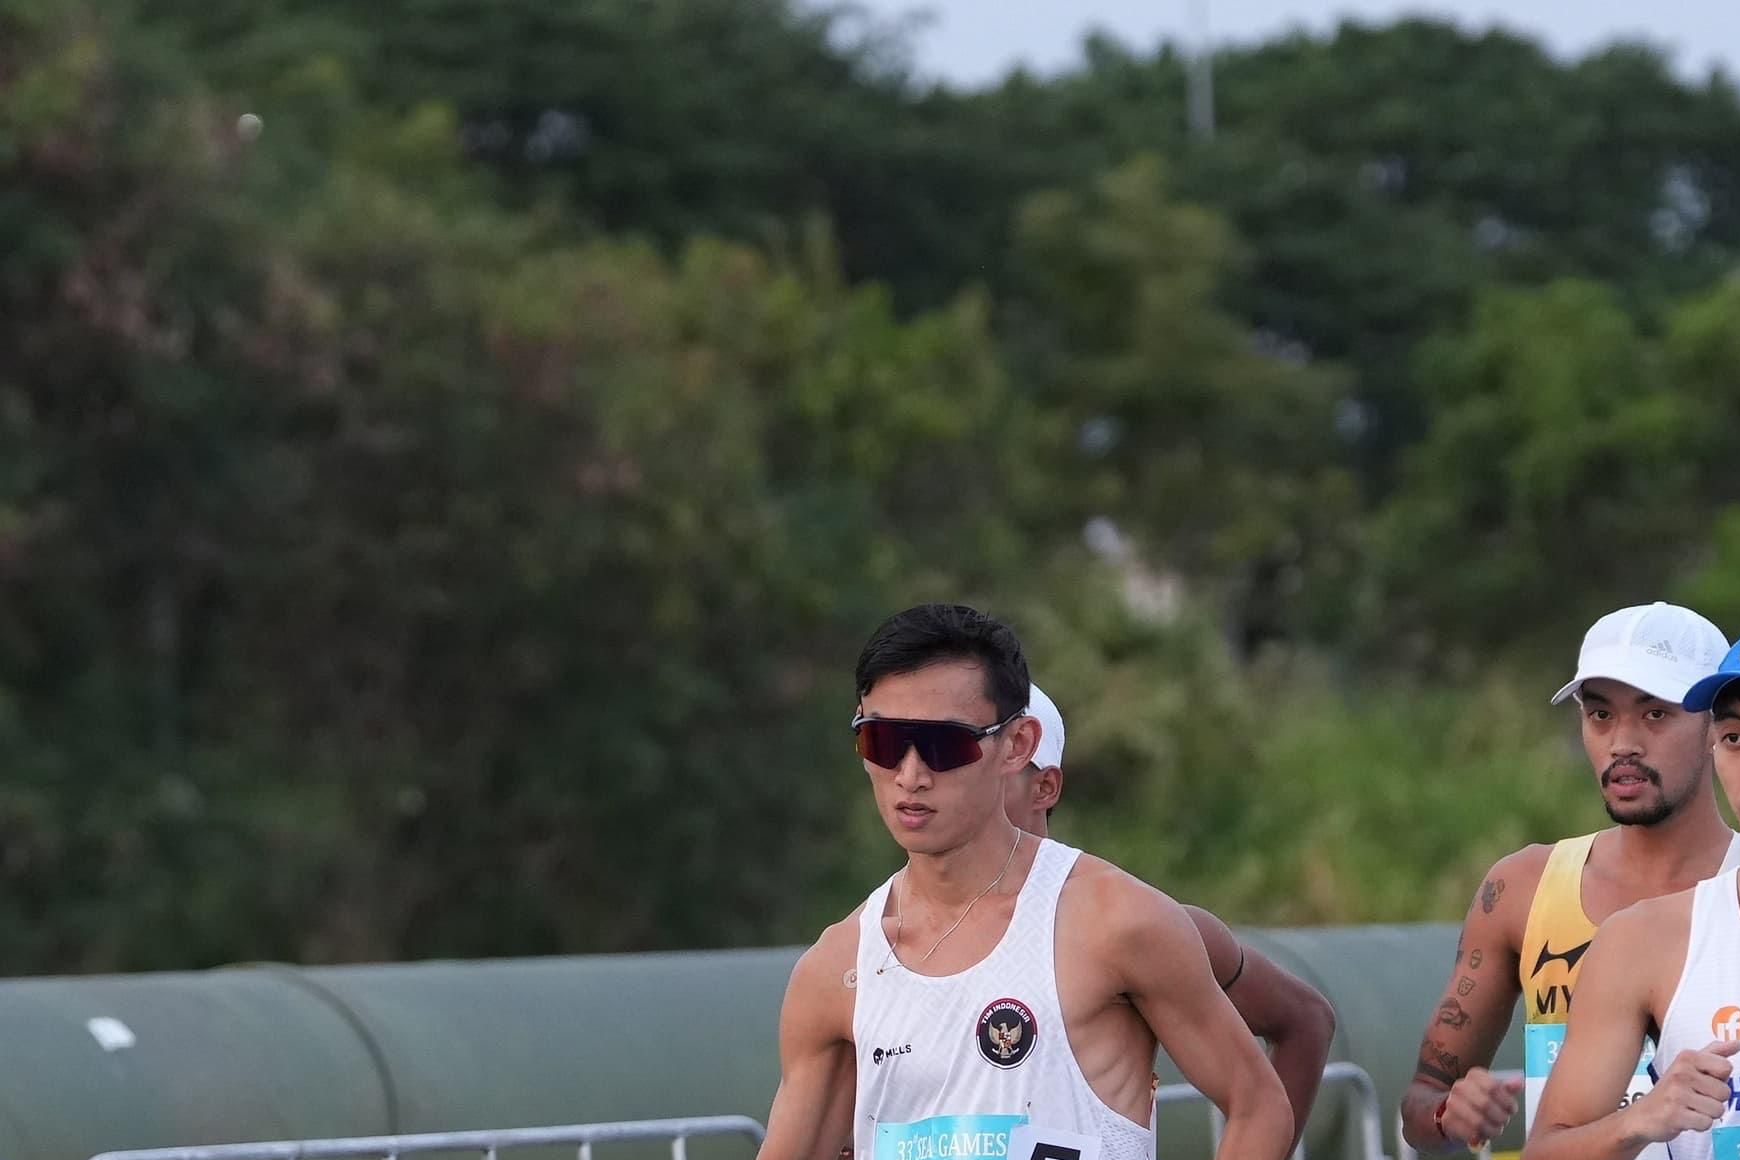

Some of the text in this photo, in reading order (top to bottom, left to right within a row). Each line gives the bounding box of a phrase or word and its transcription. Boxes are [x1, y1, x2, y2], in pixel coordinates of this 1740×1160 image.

[1646, 648, 1679, 663] adidas
[981, 1002, 1030, 1025] TIM INDONESIA
[886, 1044, 912, 1058] MILLS
[938, 1132, 1008, 1158] GAMES
